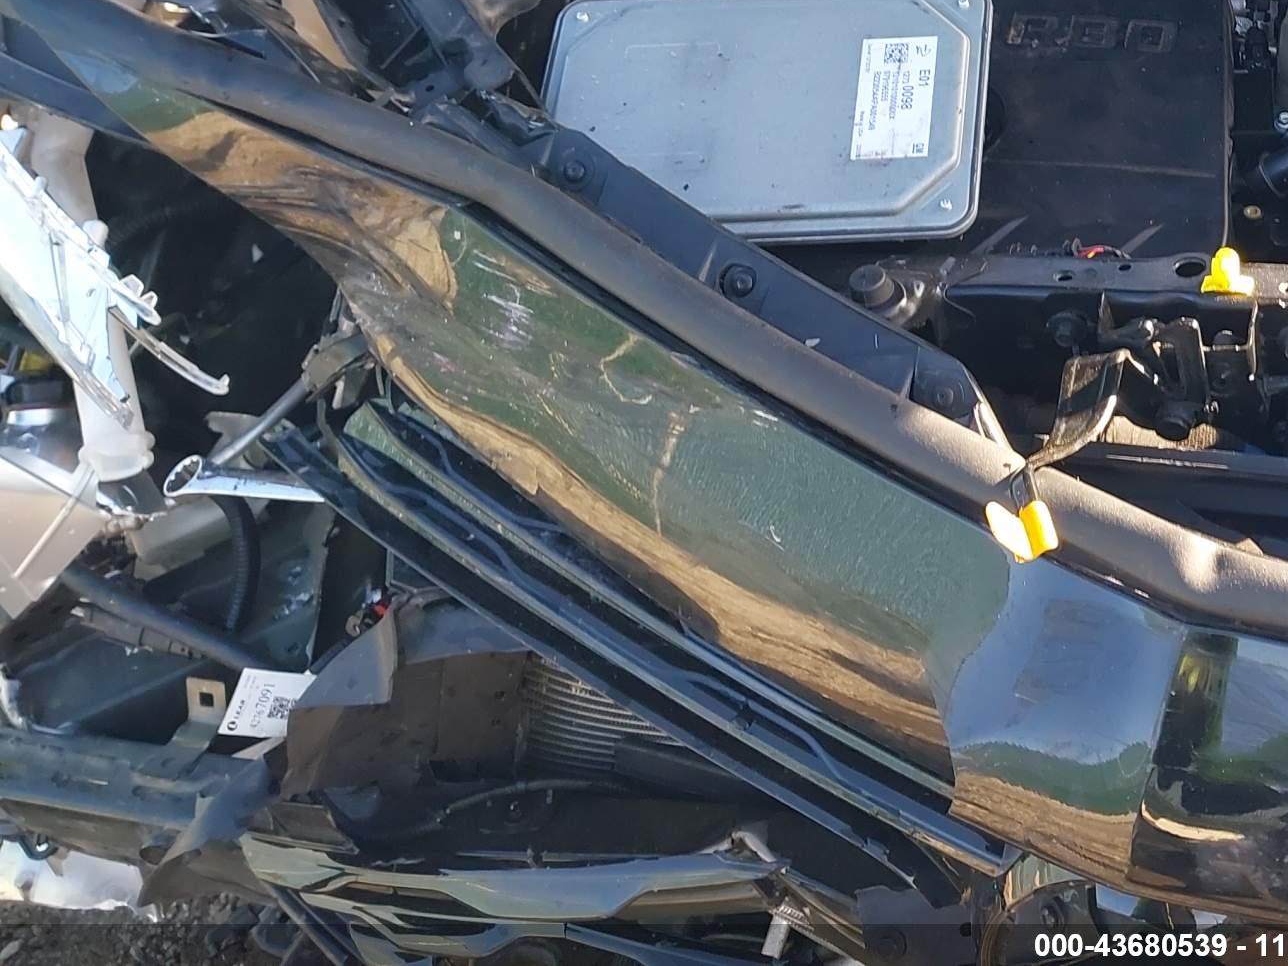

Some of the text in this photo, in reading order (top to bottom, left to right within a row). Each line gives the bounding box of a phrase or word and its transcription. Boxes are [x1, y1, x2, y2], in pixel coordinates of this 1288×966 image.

[1007, 11, 1178, 52] RBO
[918, 68, 931, 86] E01
[901, 85, 914, 110] 0098
